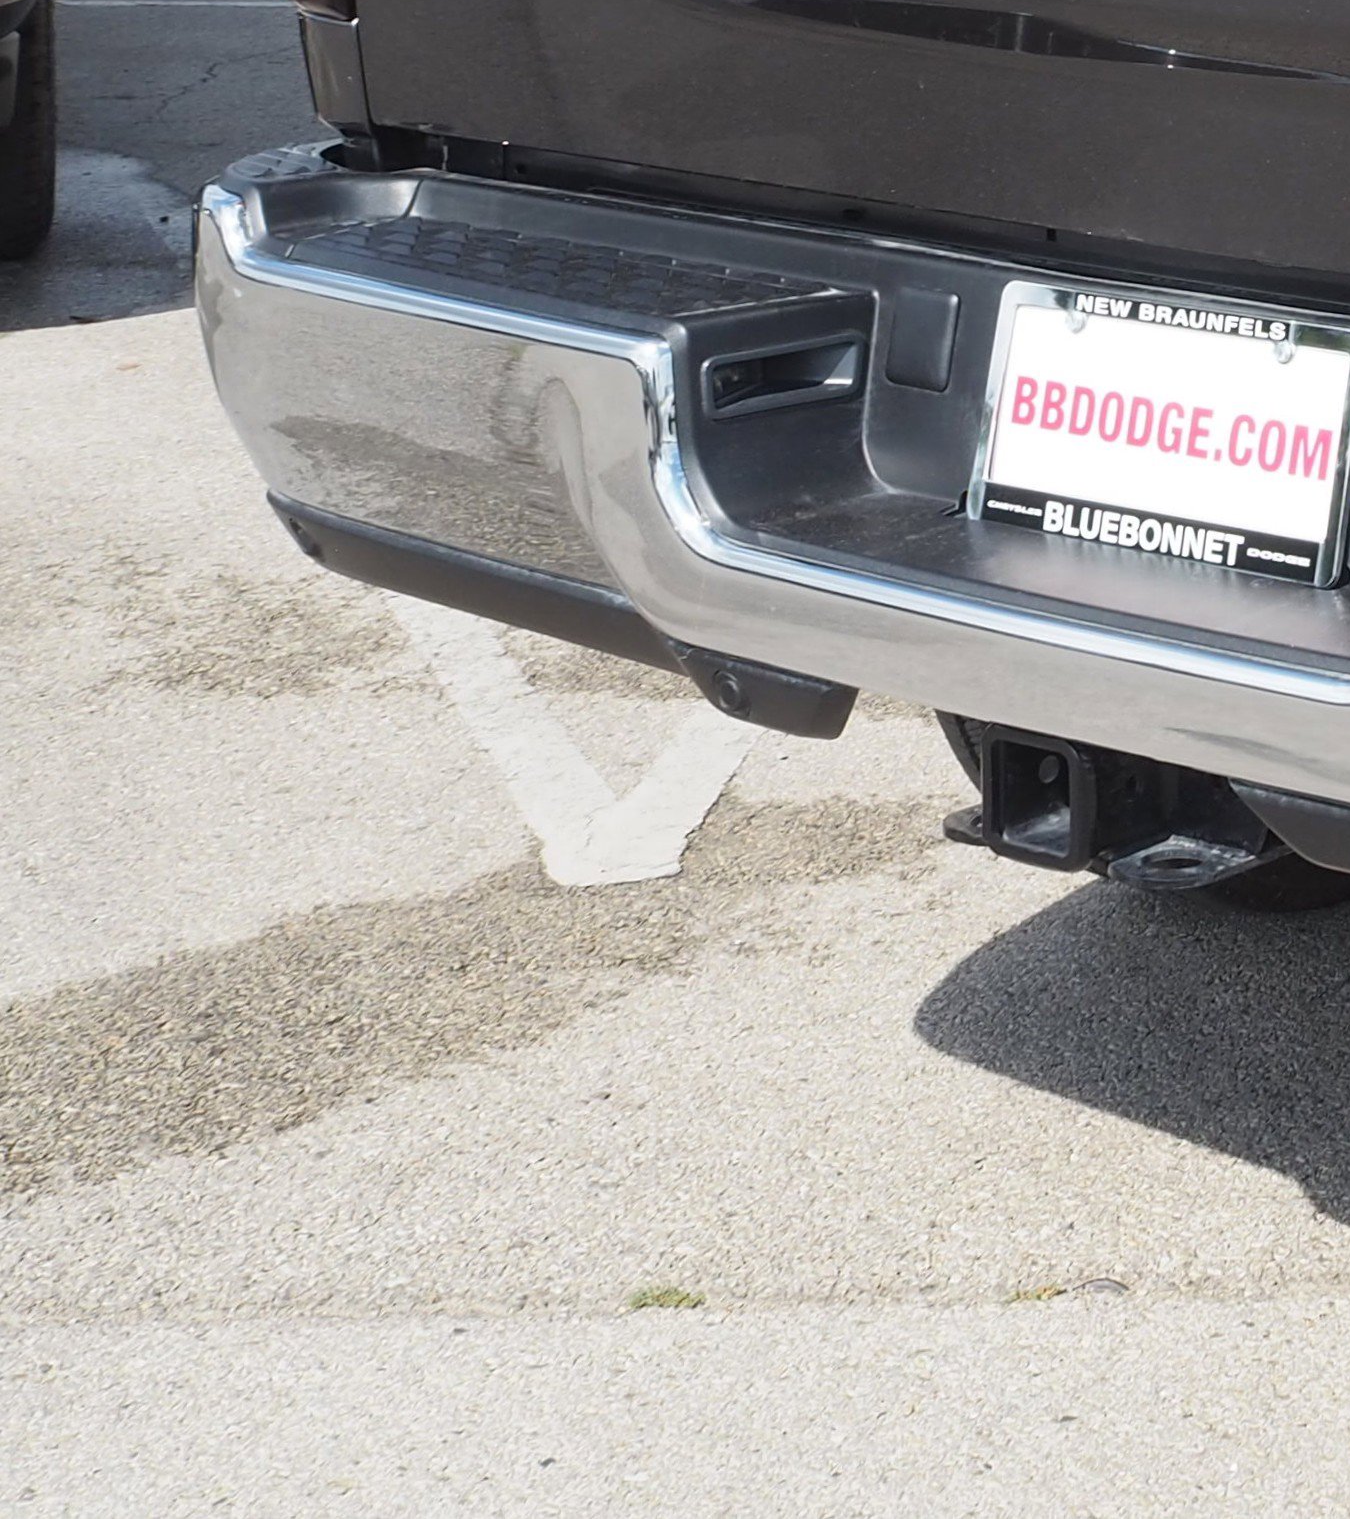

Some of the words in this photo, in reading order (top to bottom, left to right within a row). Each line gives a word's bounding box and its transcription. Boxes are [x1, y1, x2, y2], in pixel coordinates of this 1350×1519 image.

[1076, 294, 1132, 318] NEW
[1138, 303, 1287, 341] BRAUNFELS
[1011, 375, 1333, 481] BBDODGE.COM
[1042, 500, 1245, 566] BLUEBONNET
[1246, 547, 1311, 568] DODGE
